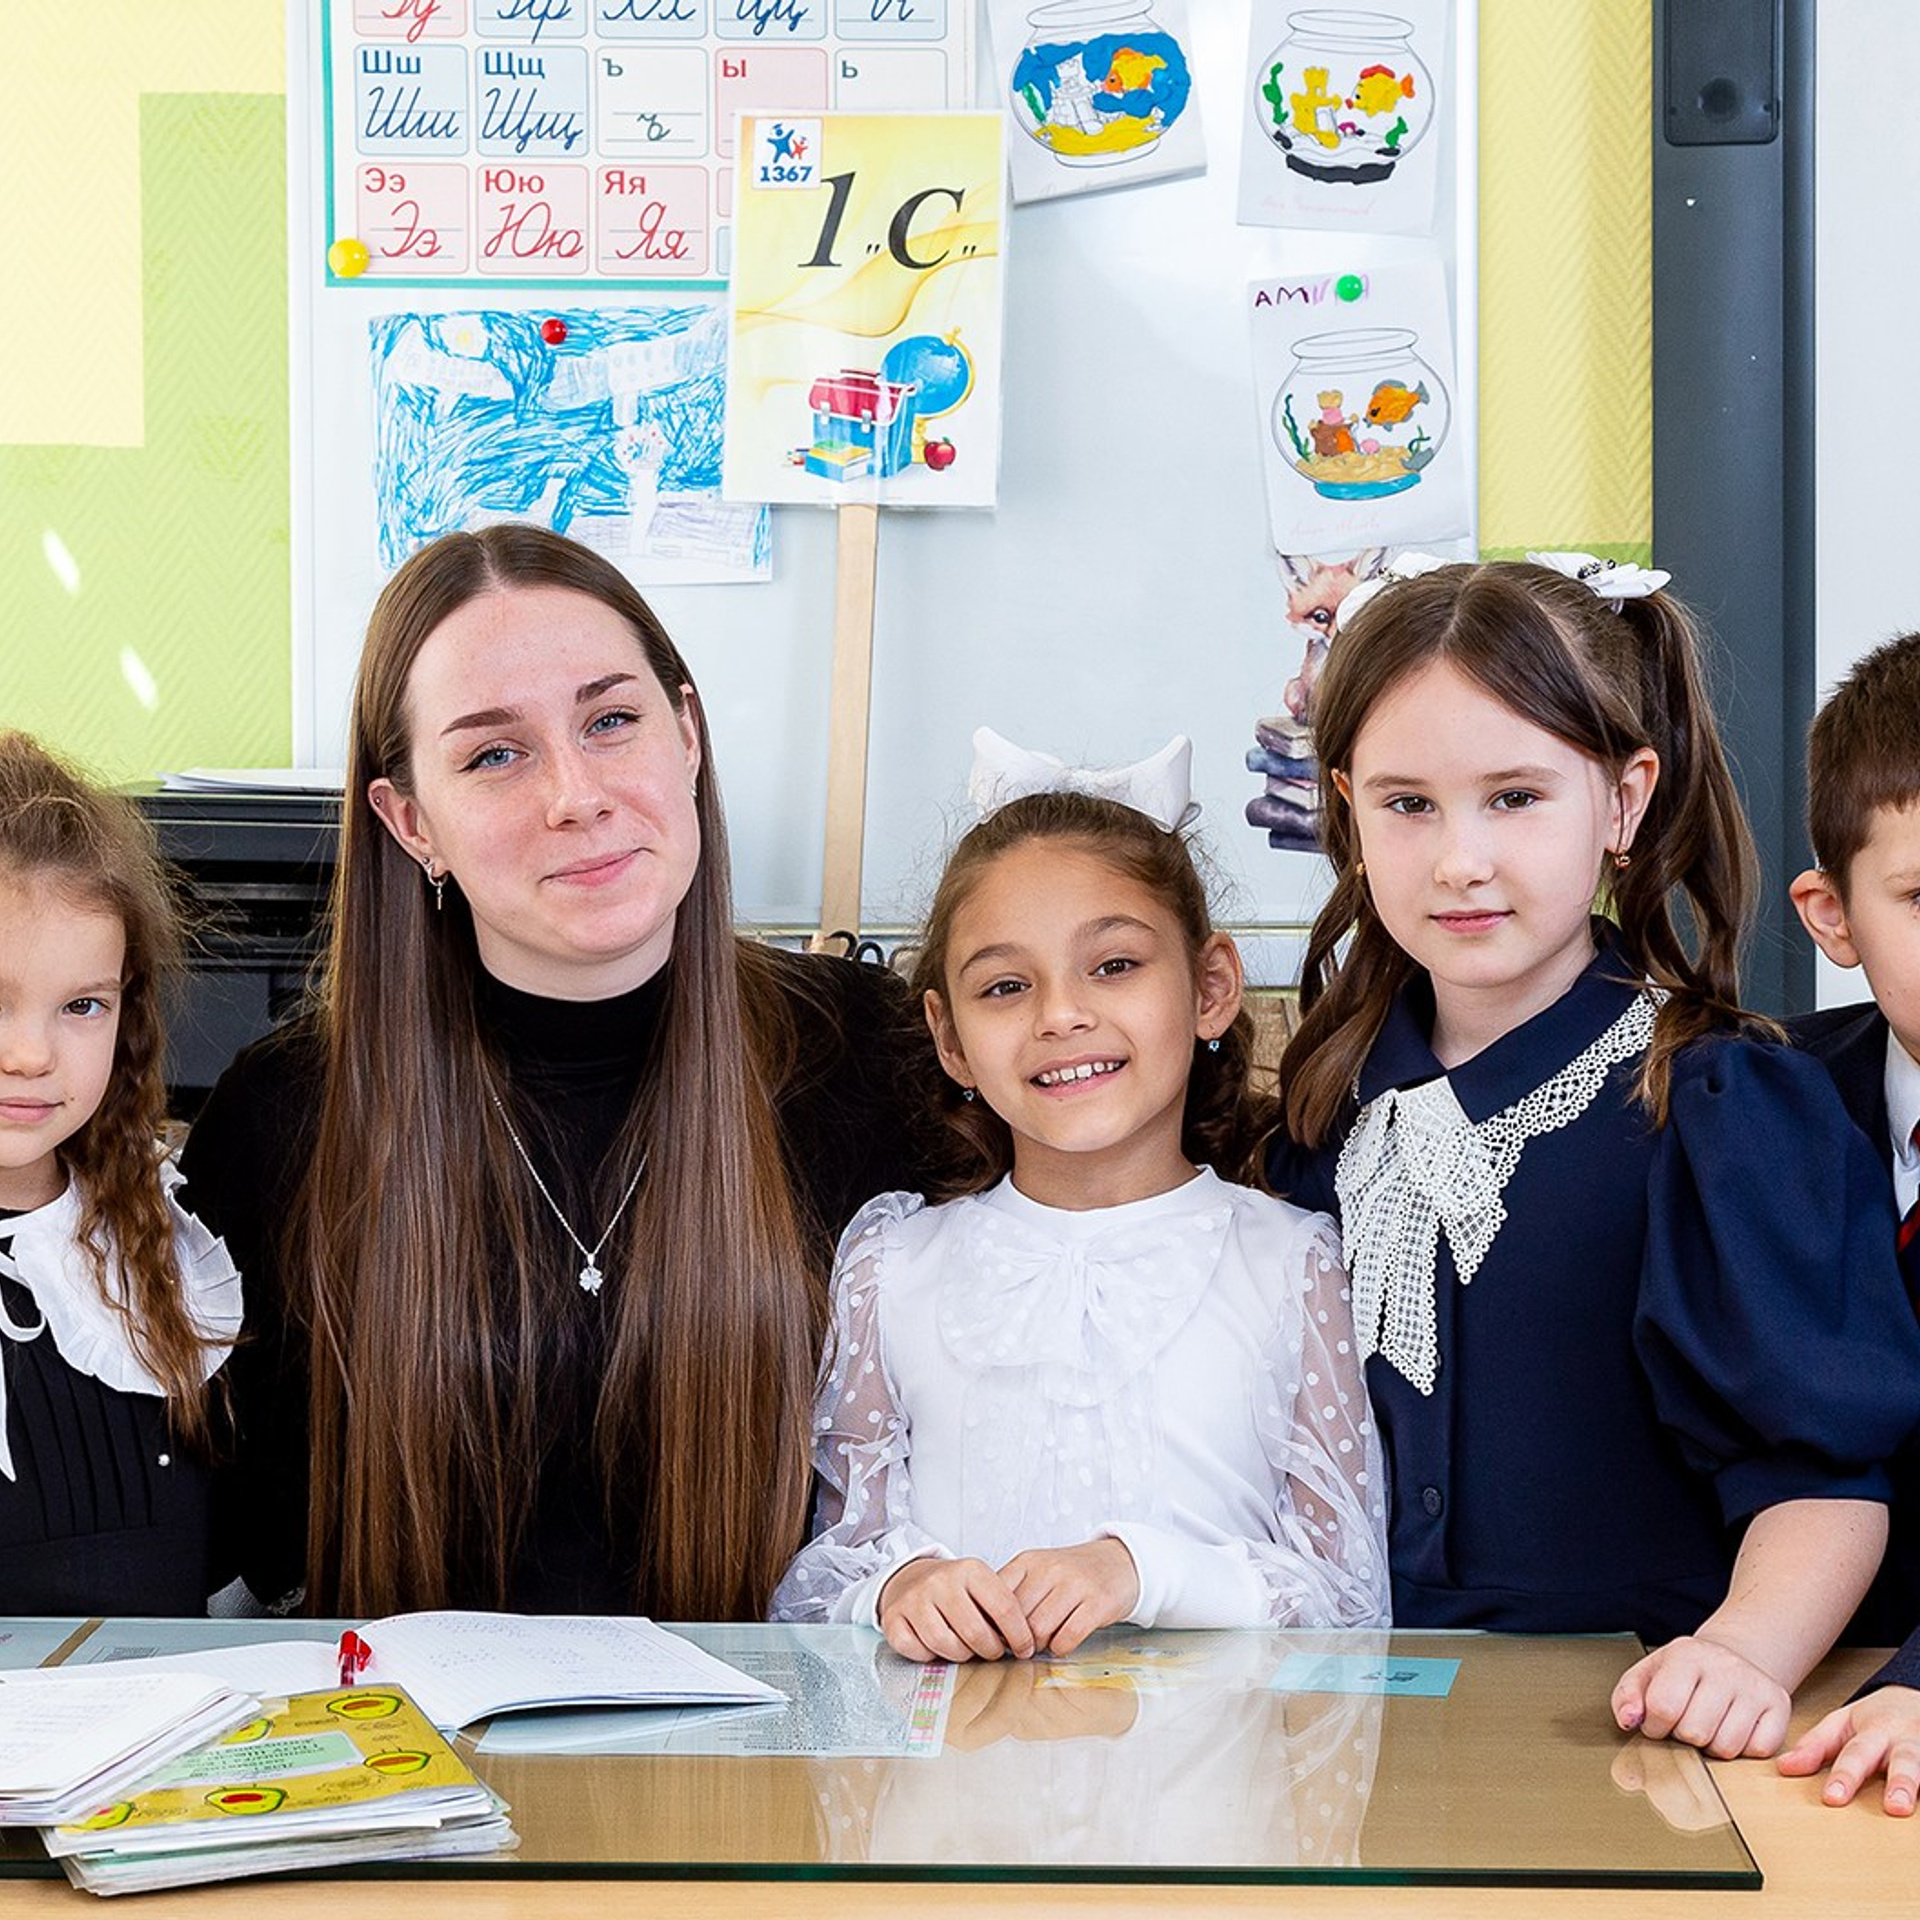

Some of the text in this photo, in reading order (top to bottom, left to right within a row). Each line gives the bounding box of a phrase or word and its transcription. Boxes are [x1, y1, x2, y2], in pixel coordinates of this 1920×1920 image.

[362, 50, 422, 75] Шш
[484, 51, 546, 80] Щщ
[365, 86, 460, 138] Шш
[481, 87, 584, 153] Щщ
[365, 167, 406, 193] Ээ
[485, 169, 545, 194] Юю
[604, 170, 646, 195] Яя
[760, 165, 813, 183] 1367
[380, 200, 442, 258] Ээ
[483, 202, 584, 258] Юю
[615, 201, 689, 259] Яя
